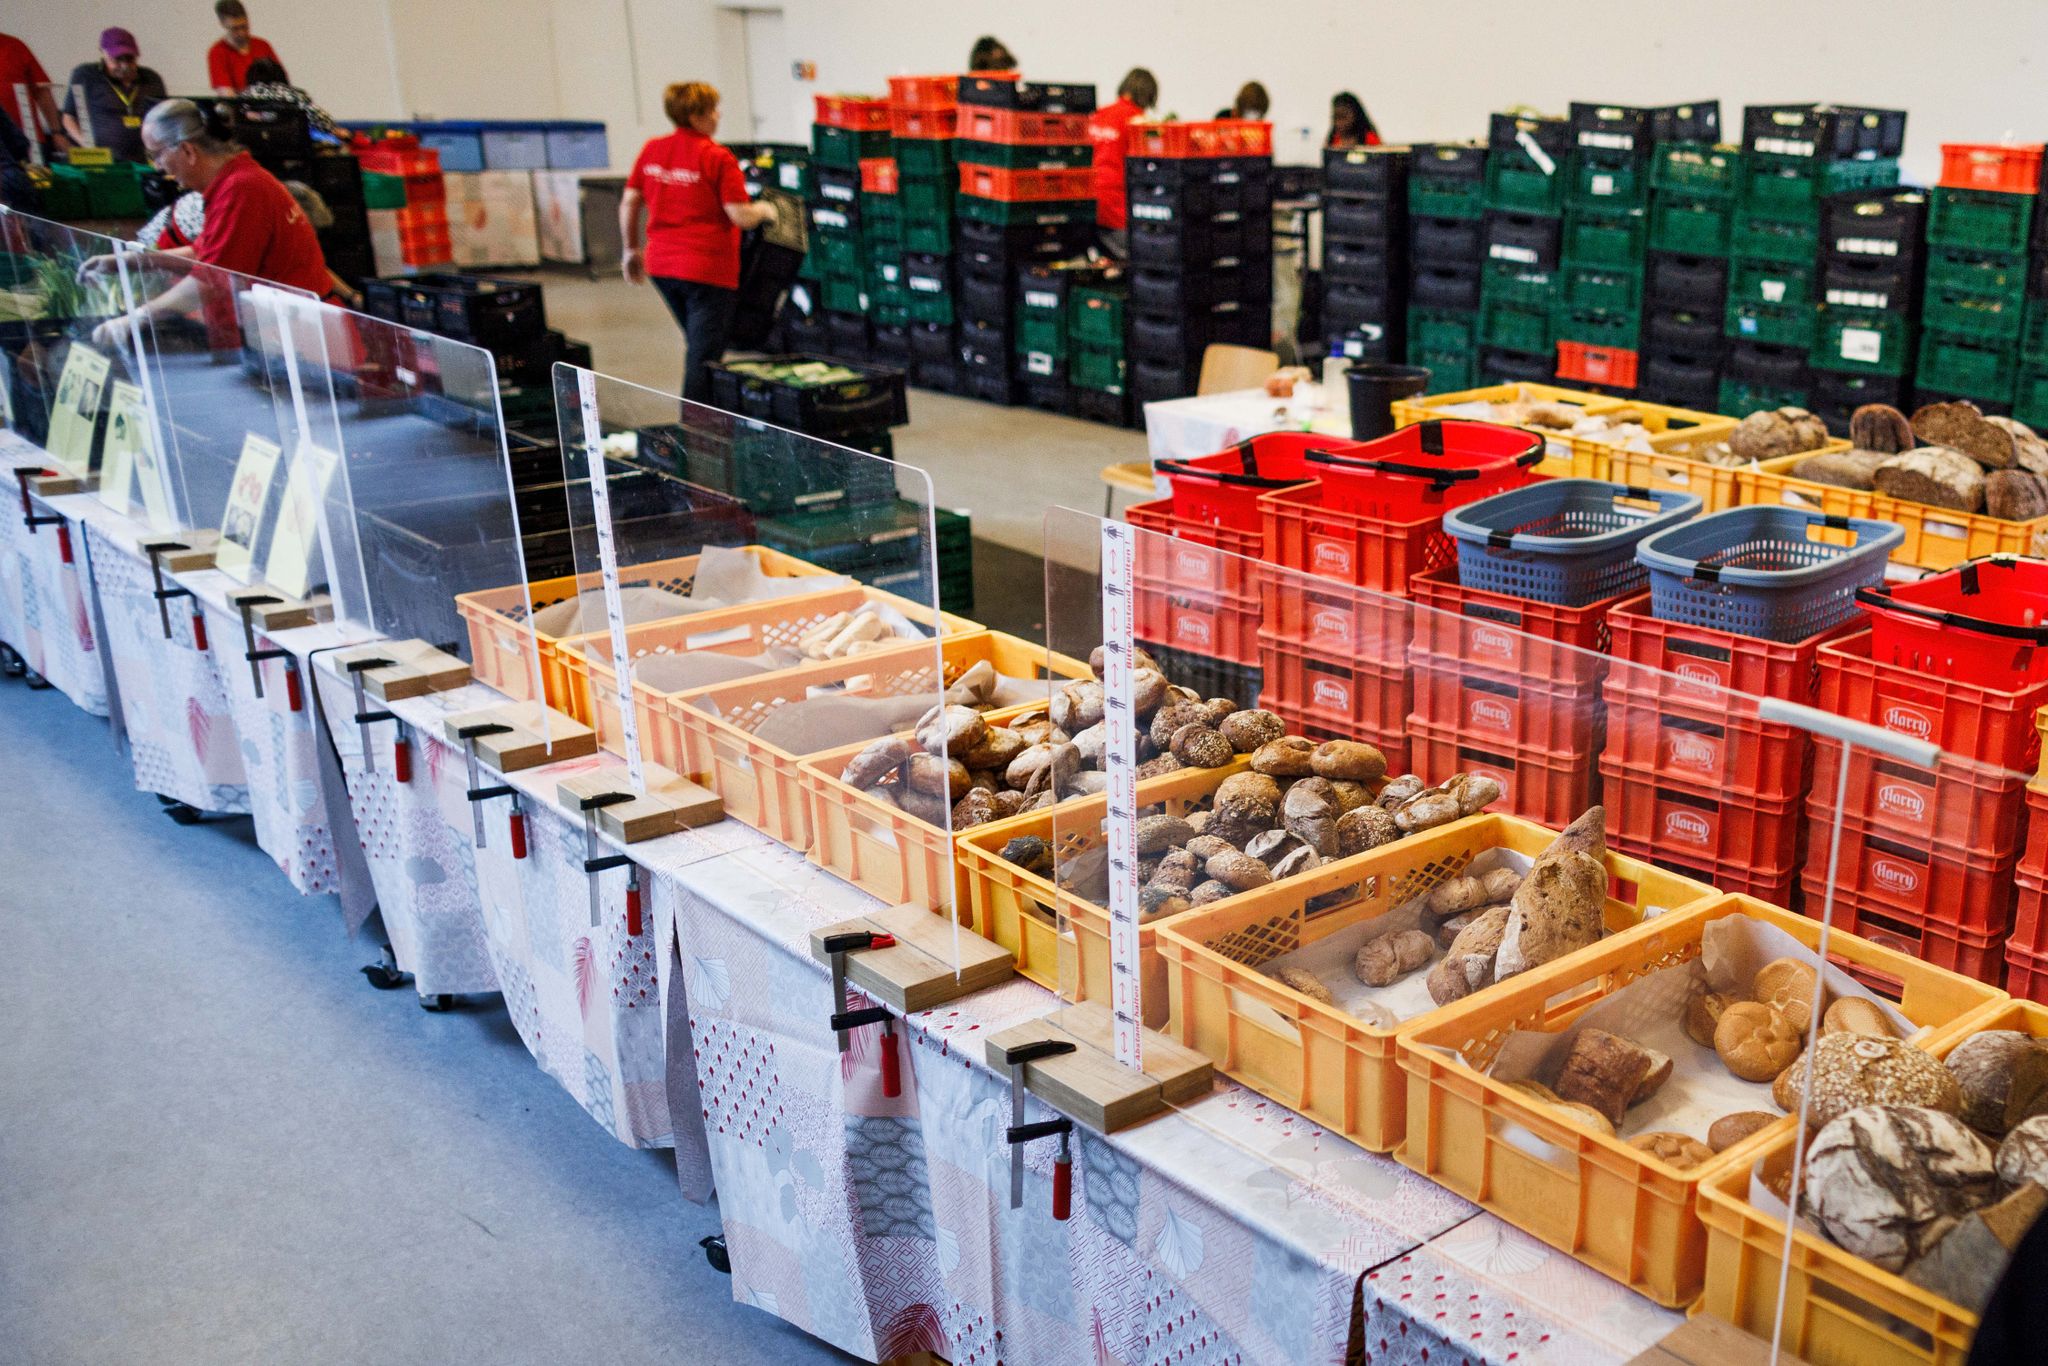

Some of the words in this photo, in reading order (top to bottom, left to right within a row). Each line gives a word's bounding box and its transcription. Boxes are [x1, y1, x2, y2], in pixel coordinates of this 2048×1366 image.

[1316, 545, 1348, 567] Harry
[1180, 618, 1208, 637] Harry
[1316, 614, 1347, 634] Harry
[1478, 629, 1511, 650] Harry
[1316, 683, 1346, 703] Harry
[1476, 701, 1508, 723] Harry
[1889, 708, 1927, 735] Harry
[1884, 785, 1921, 812] Harry
[1670, 813, 1706, 836] Harry
[1877, 863, 1914, 889] Harry
